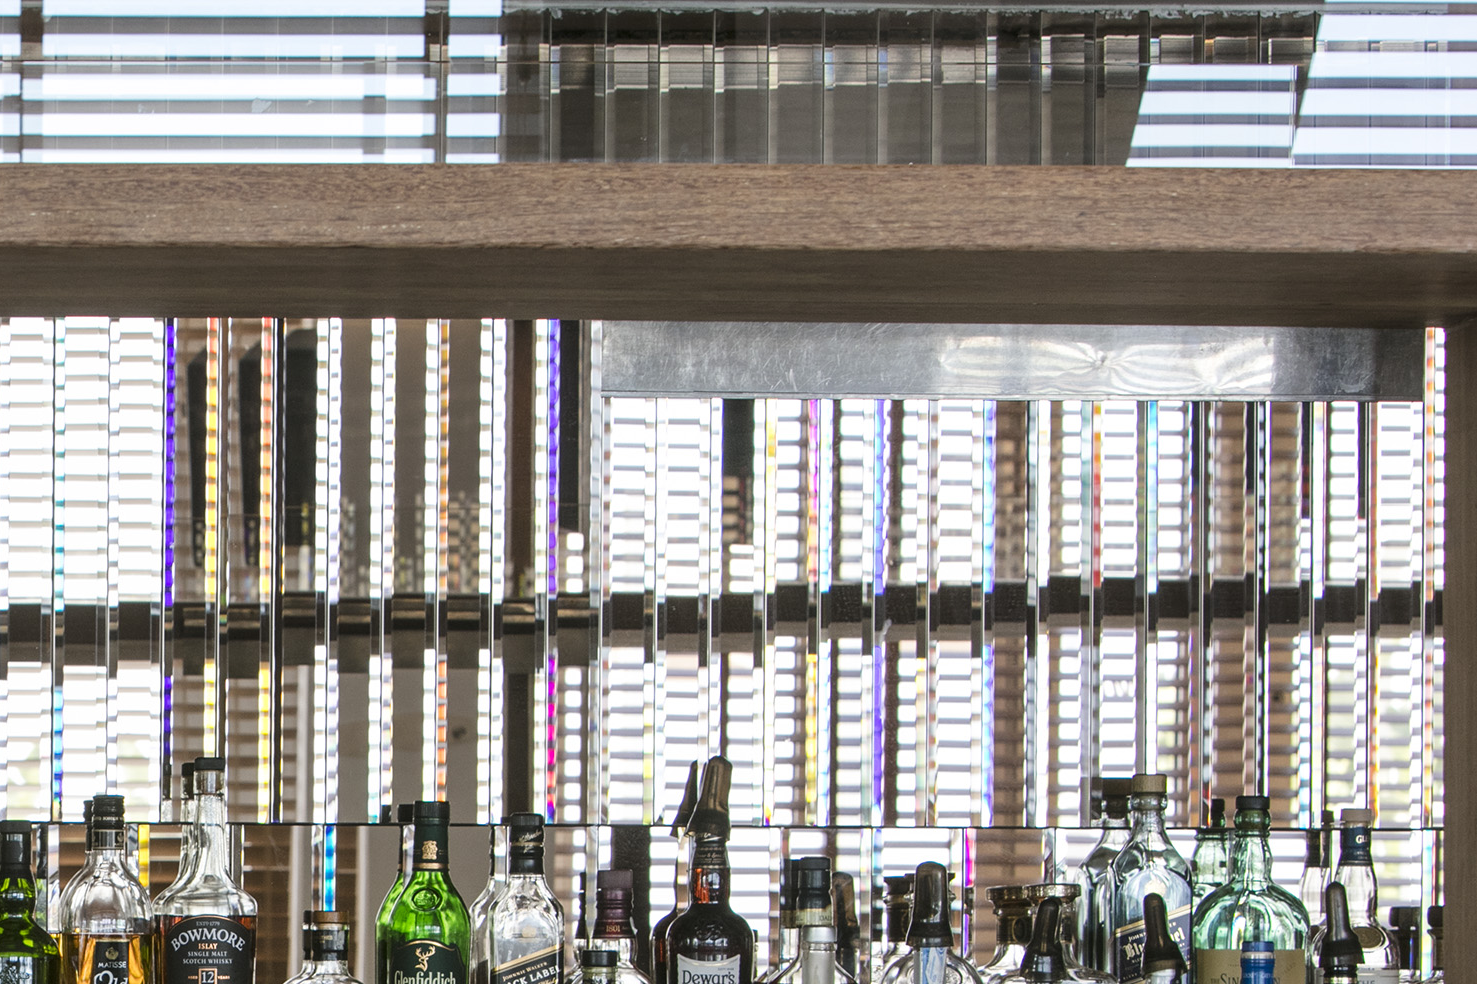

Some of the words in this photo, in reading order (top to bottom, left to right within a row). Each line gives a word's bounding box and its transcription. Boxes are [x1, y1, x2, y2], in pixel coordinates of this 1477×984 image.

[170, 927, 246, 952] BOWMORE
[1123, 942, 1145, 960] Blu
[201, 971, 215, 983] 12
[502, 969, 526, 982] JOHNNIE
[529, 964, 561, 983] LABEL
